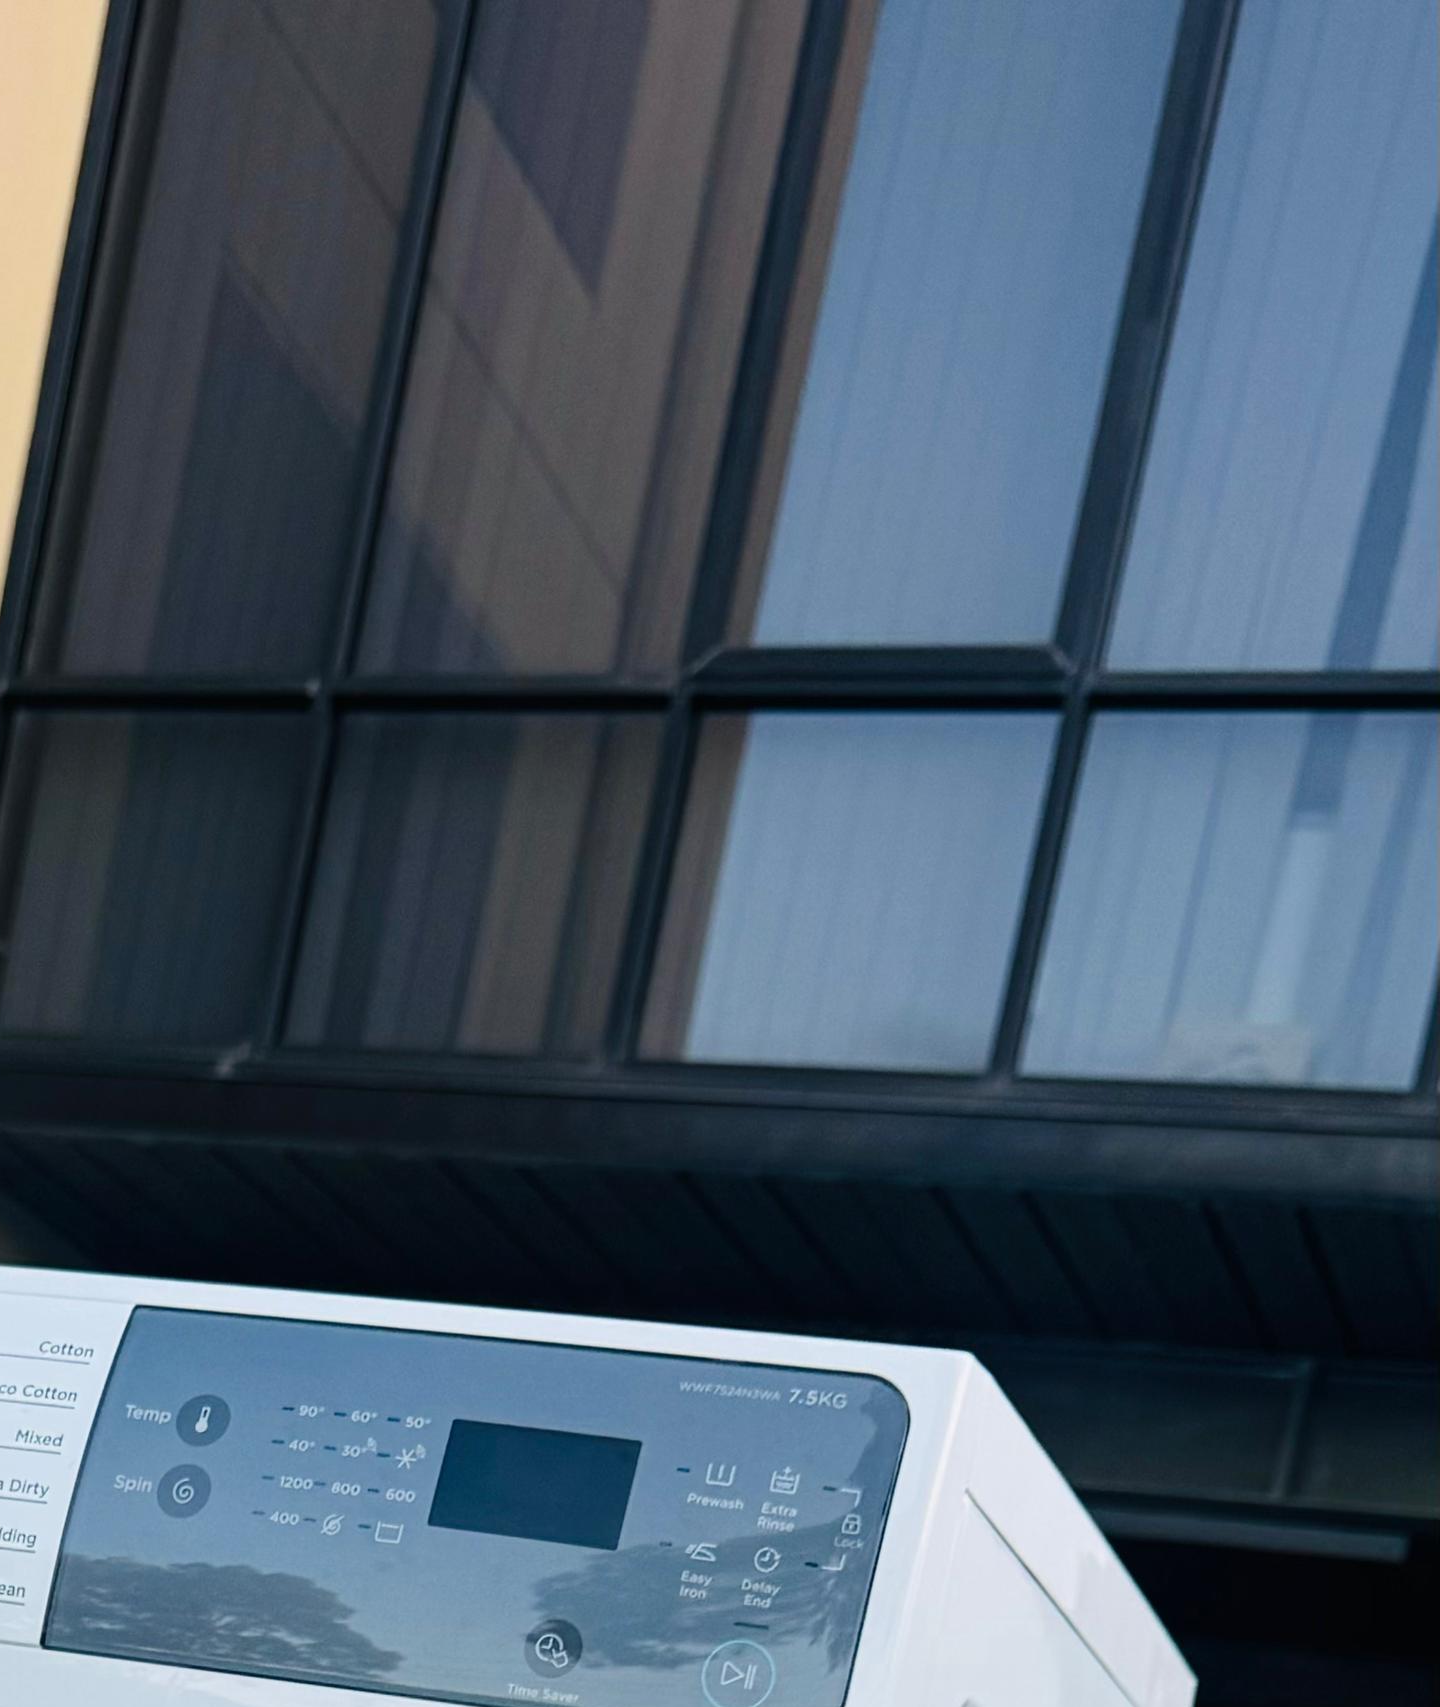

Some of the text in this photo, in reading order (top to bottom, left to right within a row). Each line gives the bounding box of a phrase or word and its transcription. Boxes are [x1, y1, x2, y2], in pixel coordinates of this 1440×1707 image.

[38, 1340, 94, 1358] Cotton
[22, 1384, 78, 1403] Cotton
[788, 1388, 848, 1409] 7.5KG
[125, 1404, 172, 1425] Temp
[15, 1429, 64, 1447] Mixed
[9, 1479, 50, 1498] Dirty
[113, 1474, 152, 1493] Spin
[280, 1476, 416, 1502] 1200 800 600
[687, 1492, 745, 1510] Prewash
[761, 1502, 798, 1518] Extra
[269, 1511, 300, 1525] 400
[757, 1516, 795, 1532] Rinse
[833, 1536, 864, 1549] Lock
[680, 1570, 712, 1586] Easy
[741, 1579, 782, 1595] Delay
[679, 1586, 707, 1599] Iron
[743, 1594, 772, 1609] End
[507, 1683, 579, 1703] Time Saver
